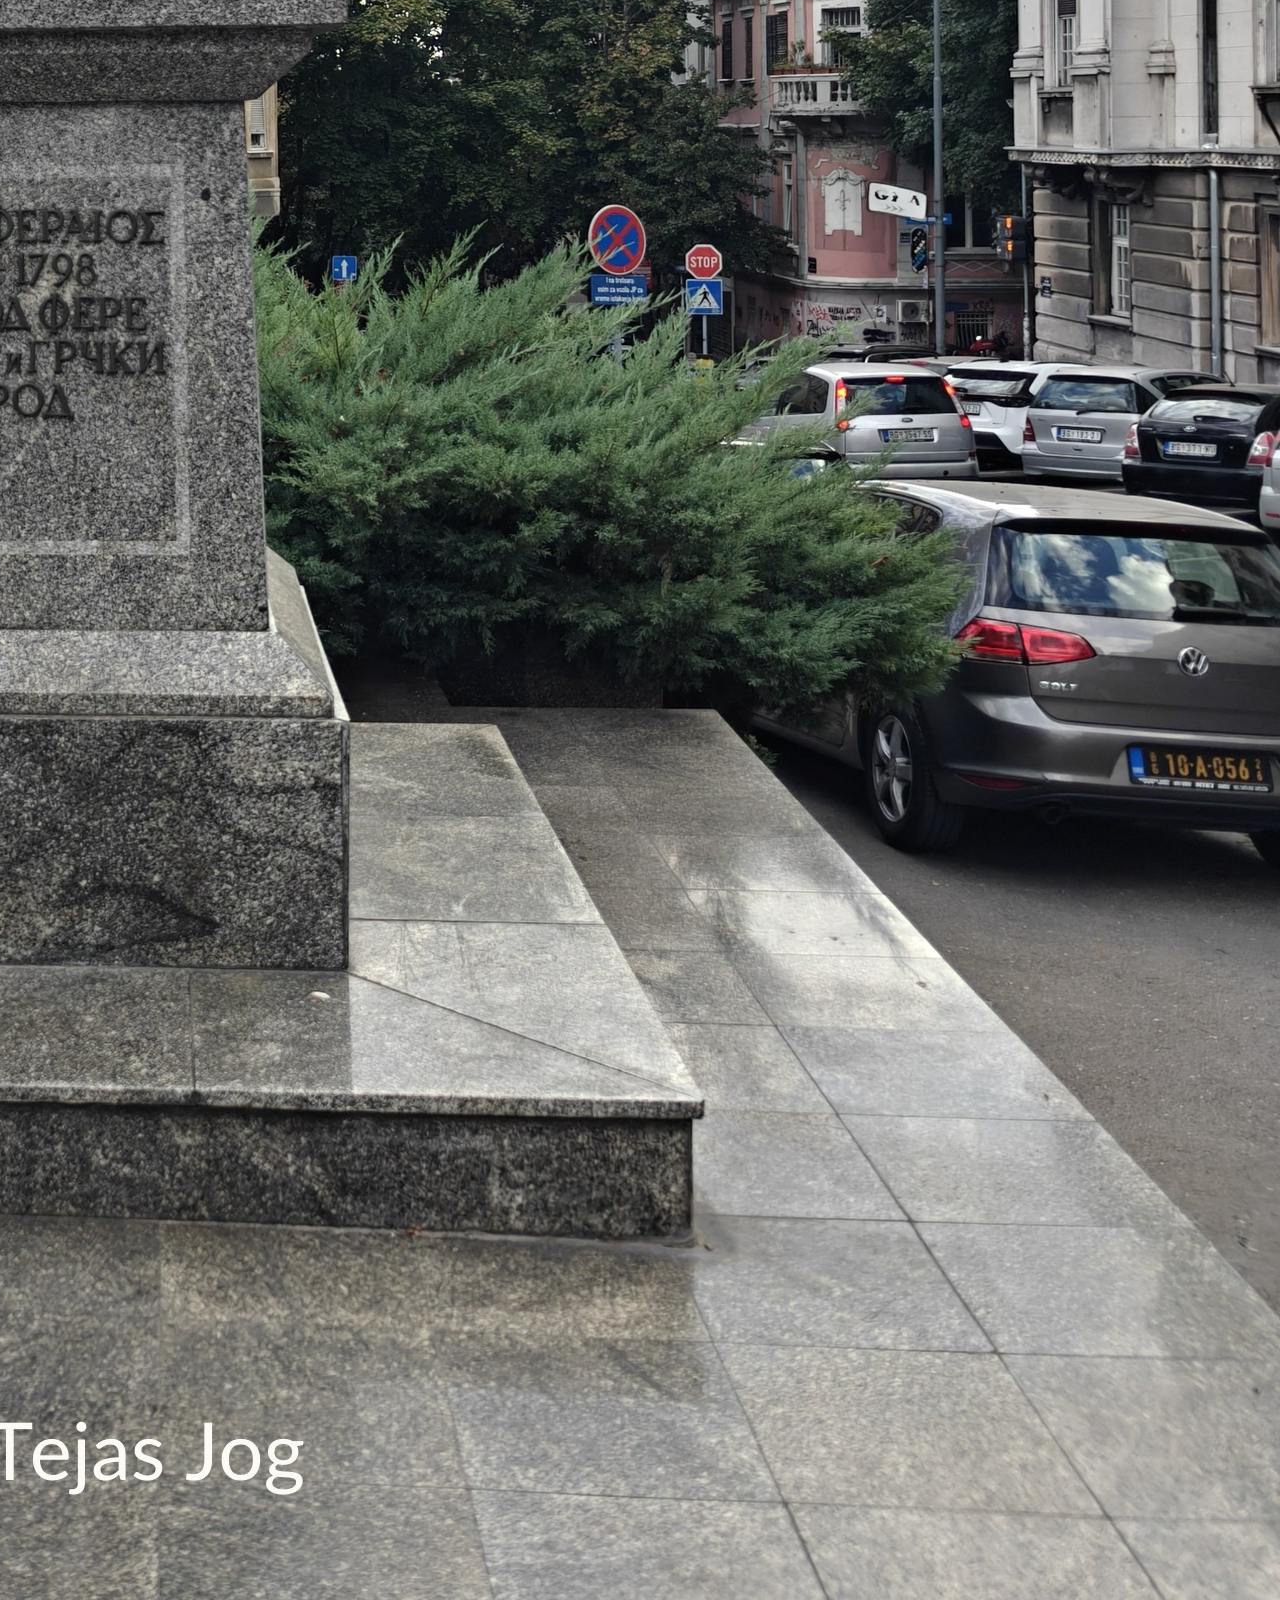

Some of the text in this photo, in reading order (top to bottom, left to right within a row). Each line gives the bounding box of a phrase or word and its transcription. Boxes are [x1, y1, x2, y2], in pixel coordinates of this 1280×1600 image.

[18, 253, 96, 287] 1798
[690, 256, 718, 268] STOP
[38, 294, 147, 334] ФЕРЕ
[27, 341, 166, 374] ГРЧКИ
[1039, 680, 1078, 691] GOLF
